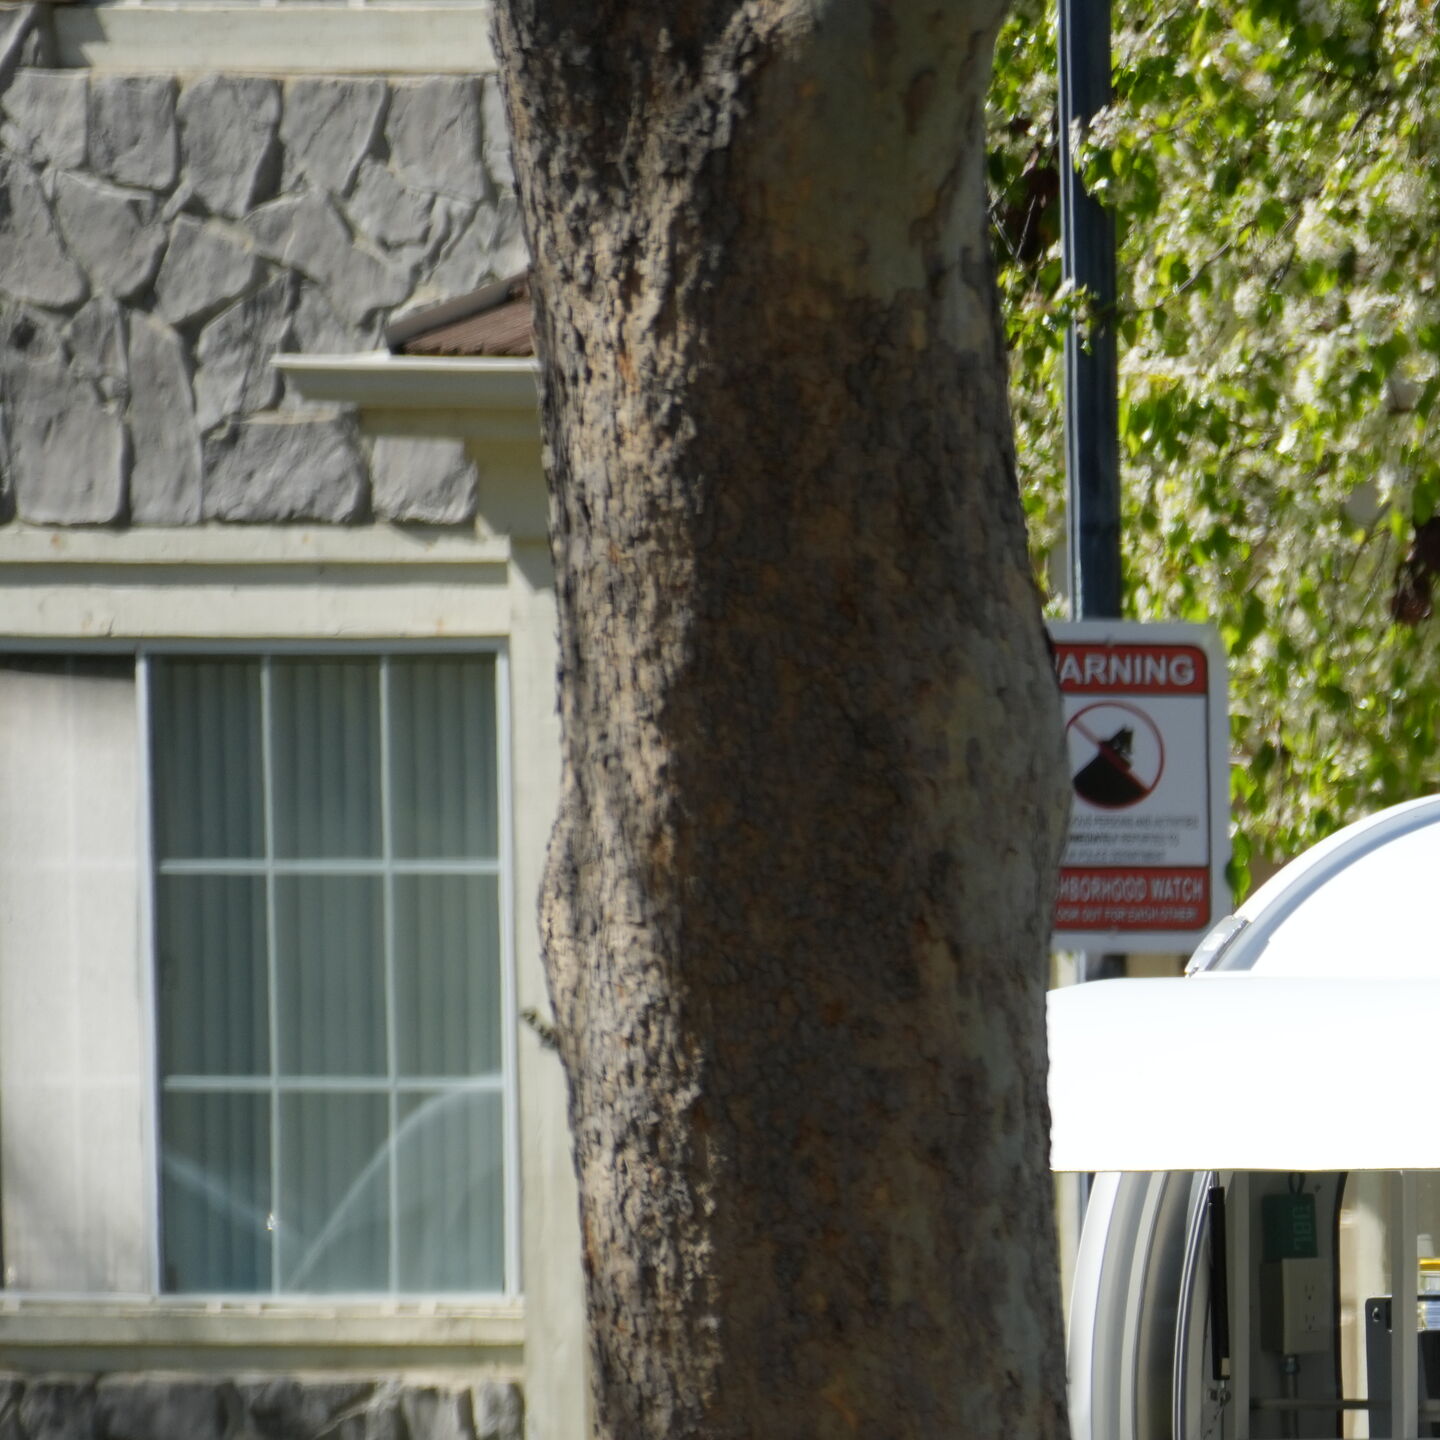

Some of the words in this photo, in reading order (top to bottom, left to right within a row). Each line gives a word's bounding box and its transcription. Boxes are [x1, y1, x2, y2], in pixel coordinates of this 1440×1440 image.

[1056, 653, 1195, 686] ARNING
[1056, 875, 1147, 902] HBORHOOD
[1151, 876, 1204, 901] WATCH
